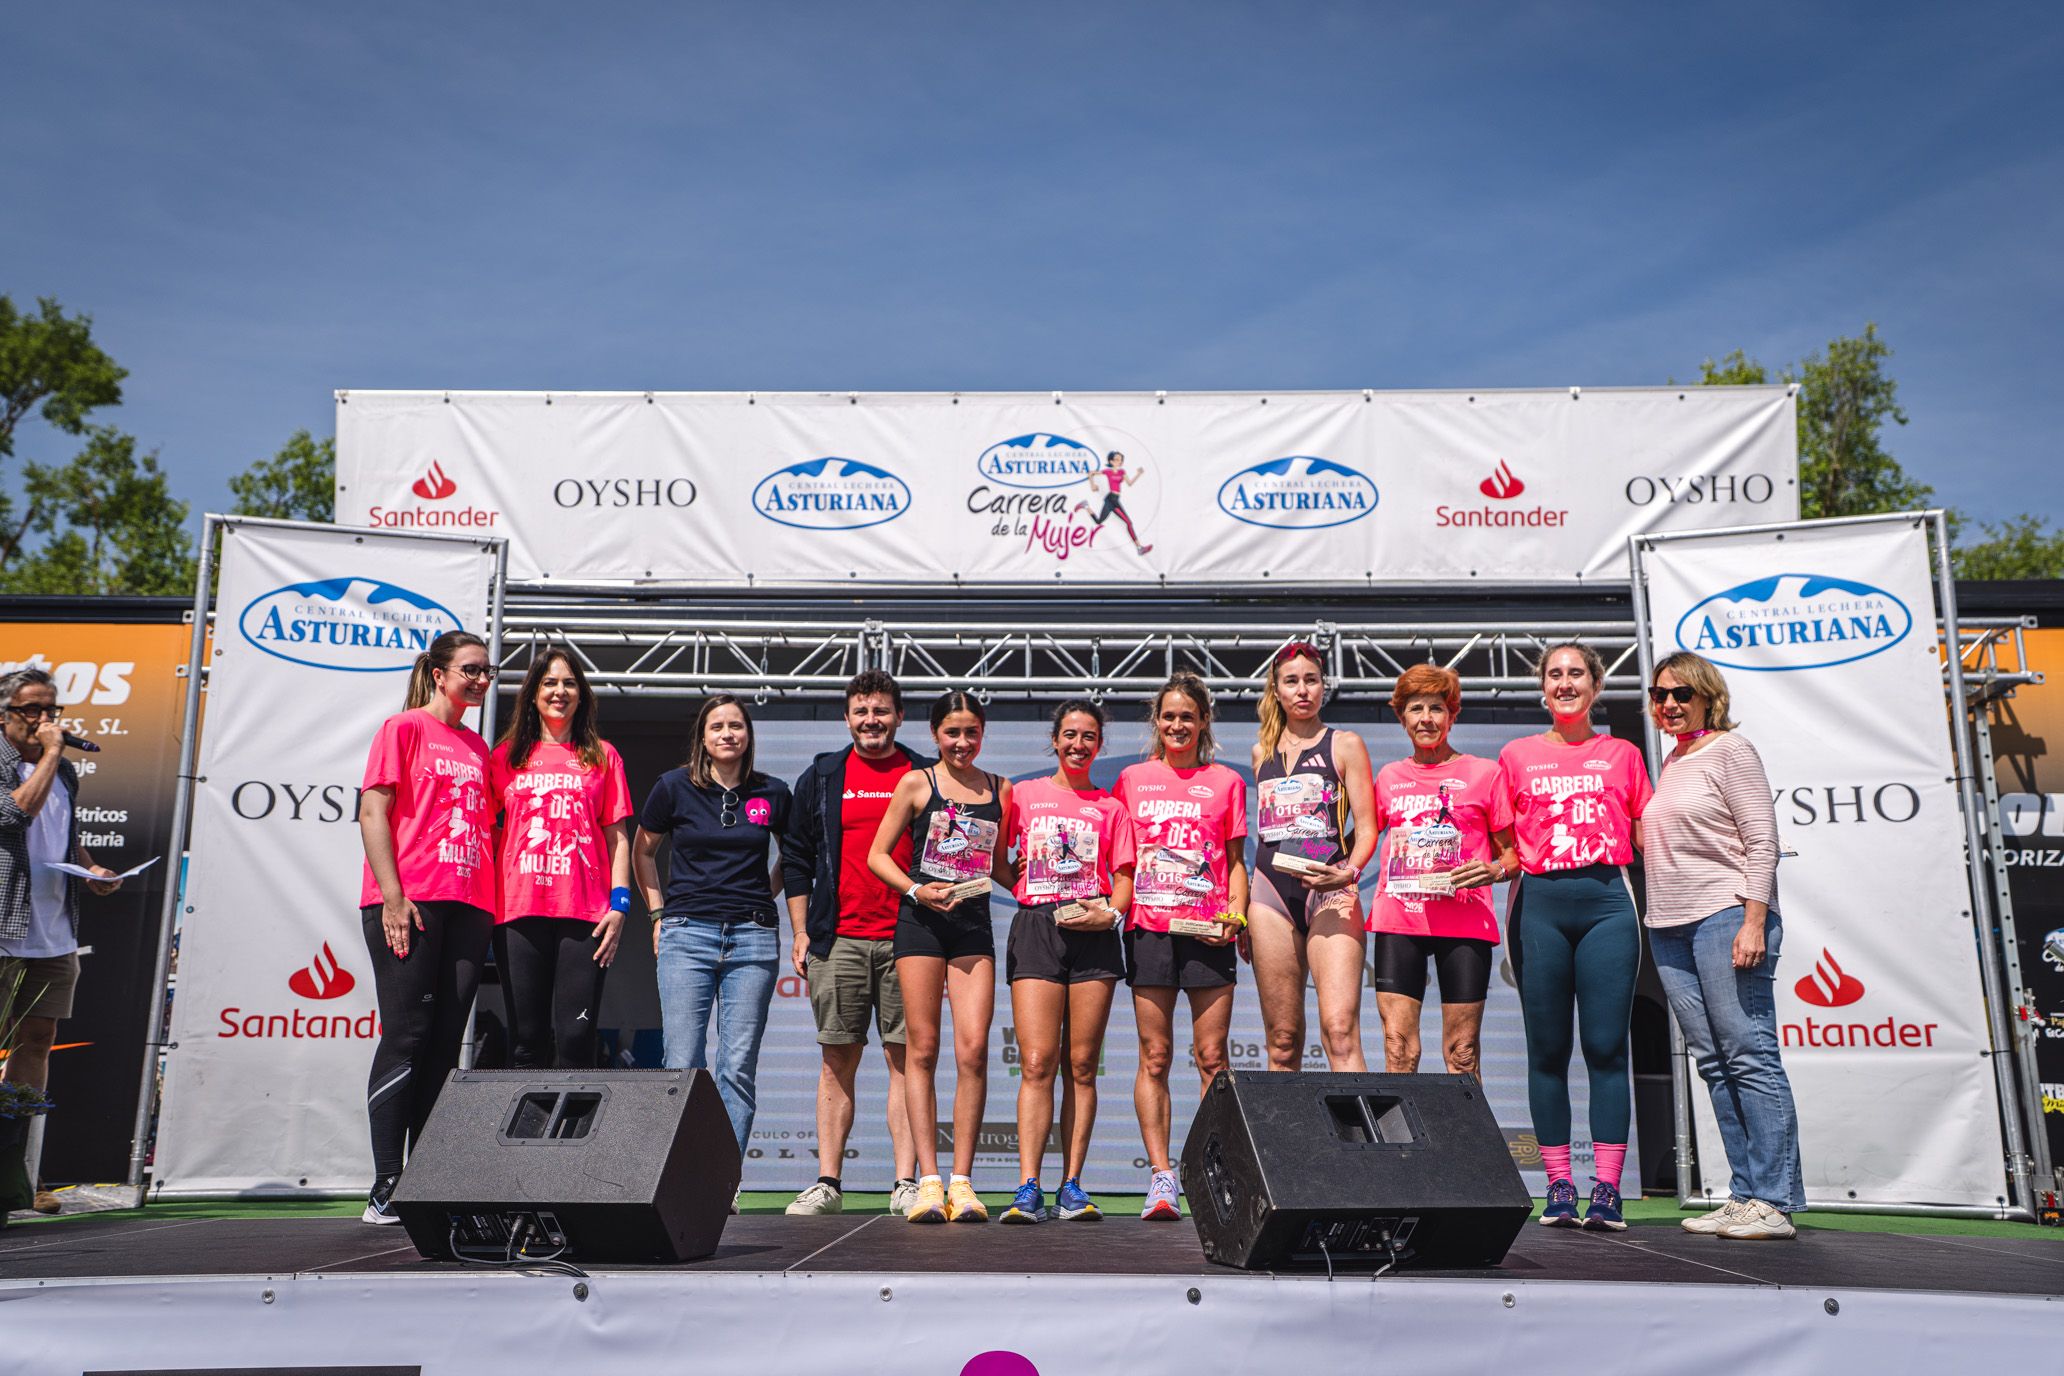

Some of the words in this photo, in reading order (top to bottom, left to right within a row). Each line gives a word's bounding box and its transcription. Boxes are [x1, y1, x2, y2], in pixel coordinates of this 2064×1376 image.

[987, 453, 1090, 475] ASTURIANA
[553, 478, 697, 508] OYSHO
[1254, 480, 1304, 488] CENTRAL
[1310, 480, 1361, 488] LECHERA
[1625, 473, 1774, 506] OYSHO
[764, 484, 900, 511] ASTURIANA
[966, 485, 1068, 514] Carrera
[1230, 483, 1366, 510] ASTURIANA
[368, 506, 500, 528] Santander
[1435, 506, 1569, 528] Santander
[991, 516, 1010, 536] de
[1014, 517, 1028, 536] la
[1025, 511, 1105, 560] Mujer
[294, 604, 364, 620] CENTRAL
[372, 611, 442, 624] LECHERA
[1726, 606, 1800, 620] CENTRAL
[1807, 600, 1884, 614] LECHERA
[1694, 614, 1895, 650] ASTURIANA
[96, 718, 129, 735] SL.
[74, 758, 97, 778] aje
[1526, 762, 1559, 773] OYSHO
[516, 773, 583, 791] CARRERA
[1137, 784, 1167, 793] OYSHO
[1531, 774, 1605, 796] CARRERA
[231, 780, 362, 823] OYS
[856, 789, 894, 799] Santan
[1773, 782, 1921, 826] SHO
[75, 806, 128, 823] tricos
[549, 793, 572, 820] DE
[1030, 802, 1059, 811] OYSHO
[1137, 800, 1202, 819] CARRERA
[1275, 805, 1302, 816] 016
[1571, 798, 1597, 825] DE
[78, 831, 124, 848] itaria
[1167, 822, 1190, 849] DE
[1417, 837, 1455, 848] Carrera
[1572, 838, 1591, 861] LA
[520, 853, 571, 875] MUJER
[1406, 857, 1434, 869] 016
[1157, 872, 1183, 883] 016
[1404, 902, 1424, 914] 2026
[218, 1007, 383, 1039] Santand
[1777, 1017, 1938, 1047] ntander
[752, 1130, 790, 1140] CULO
